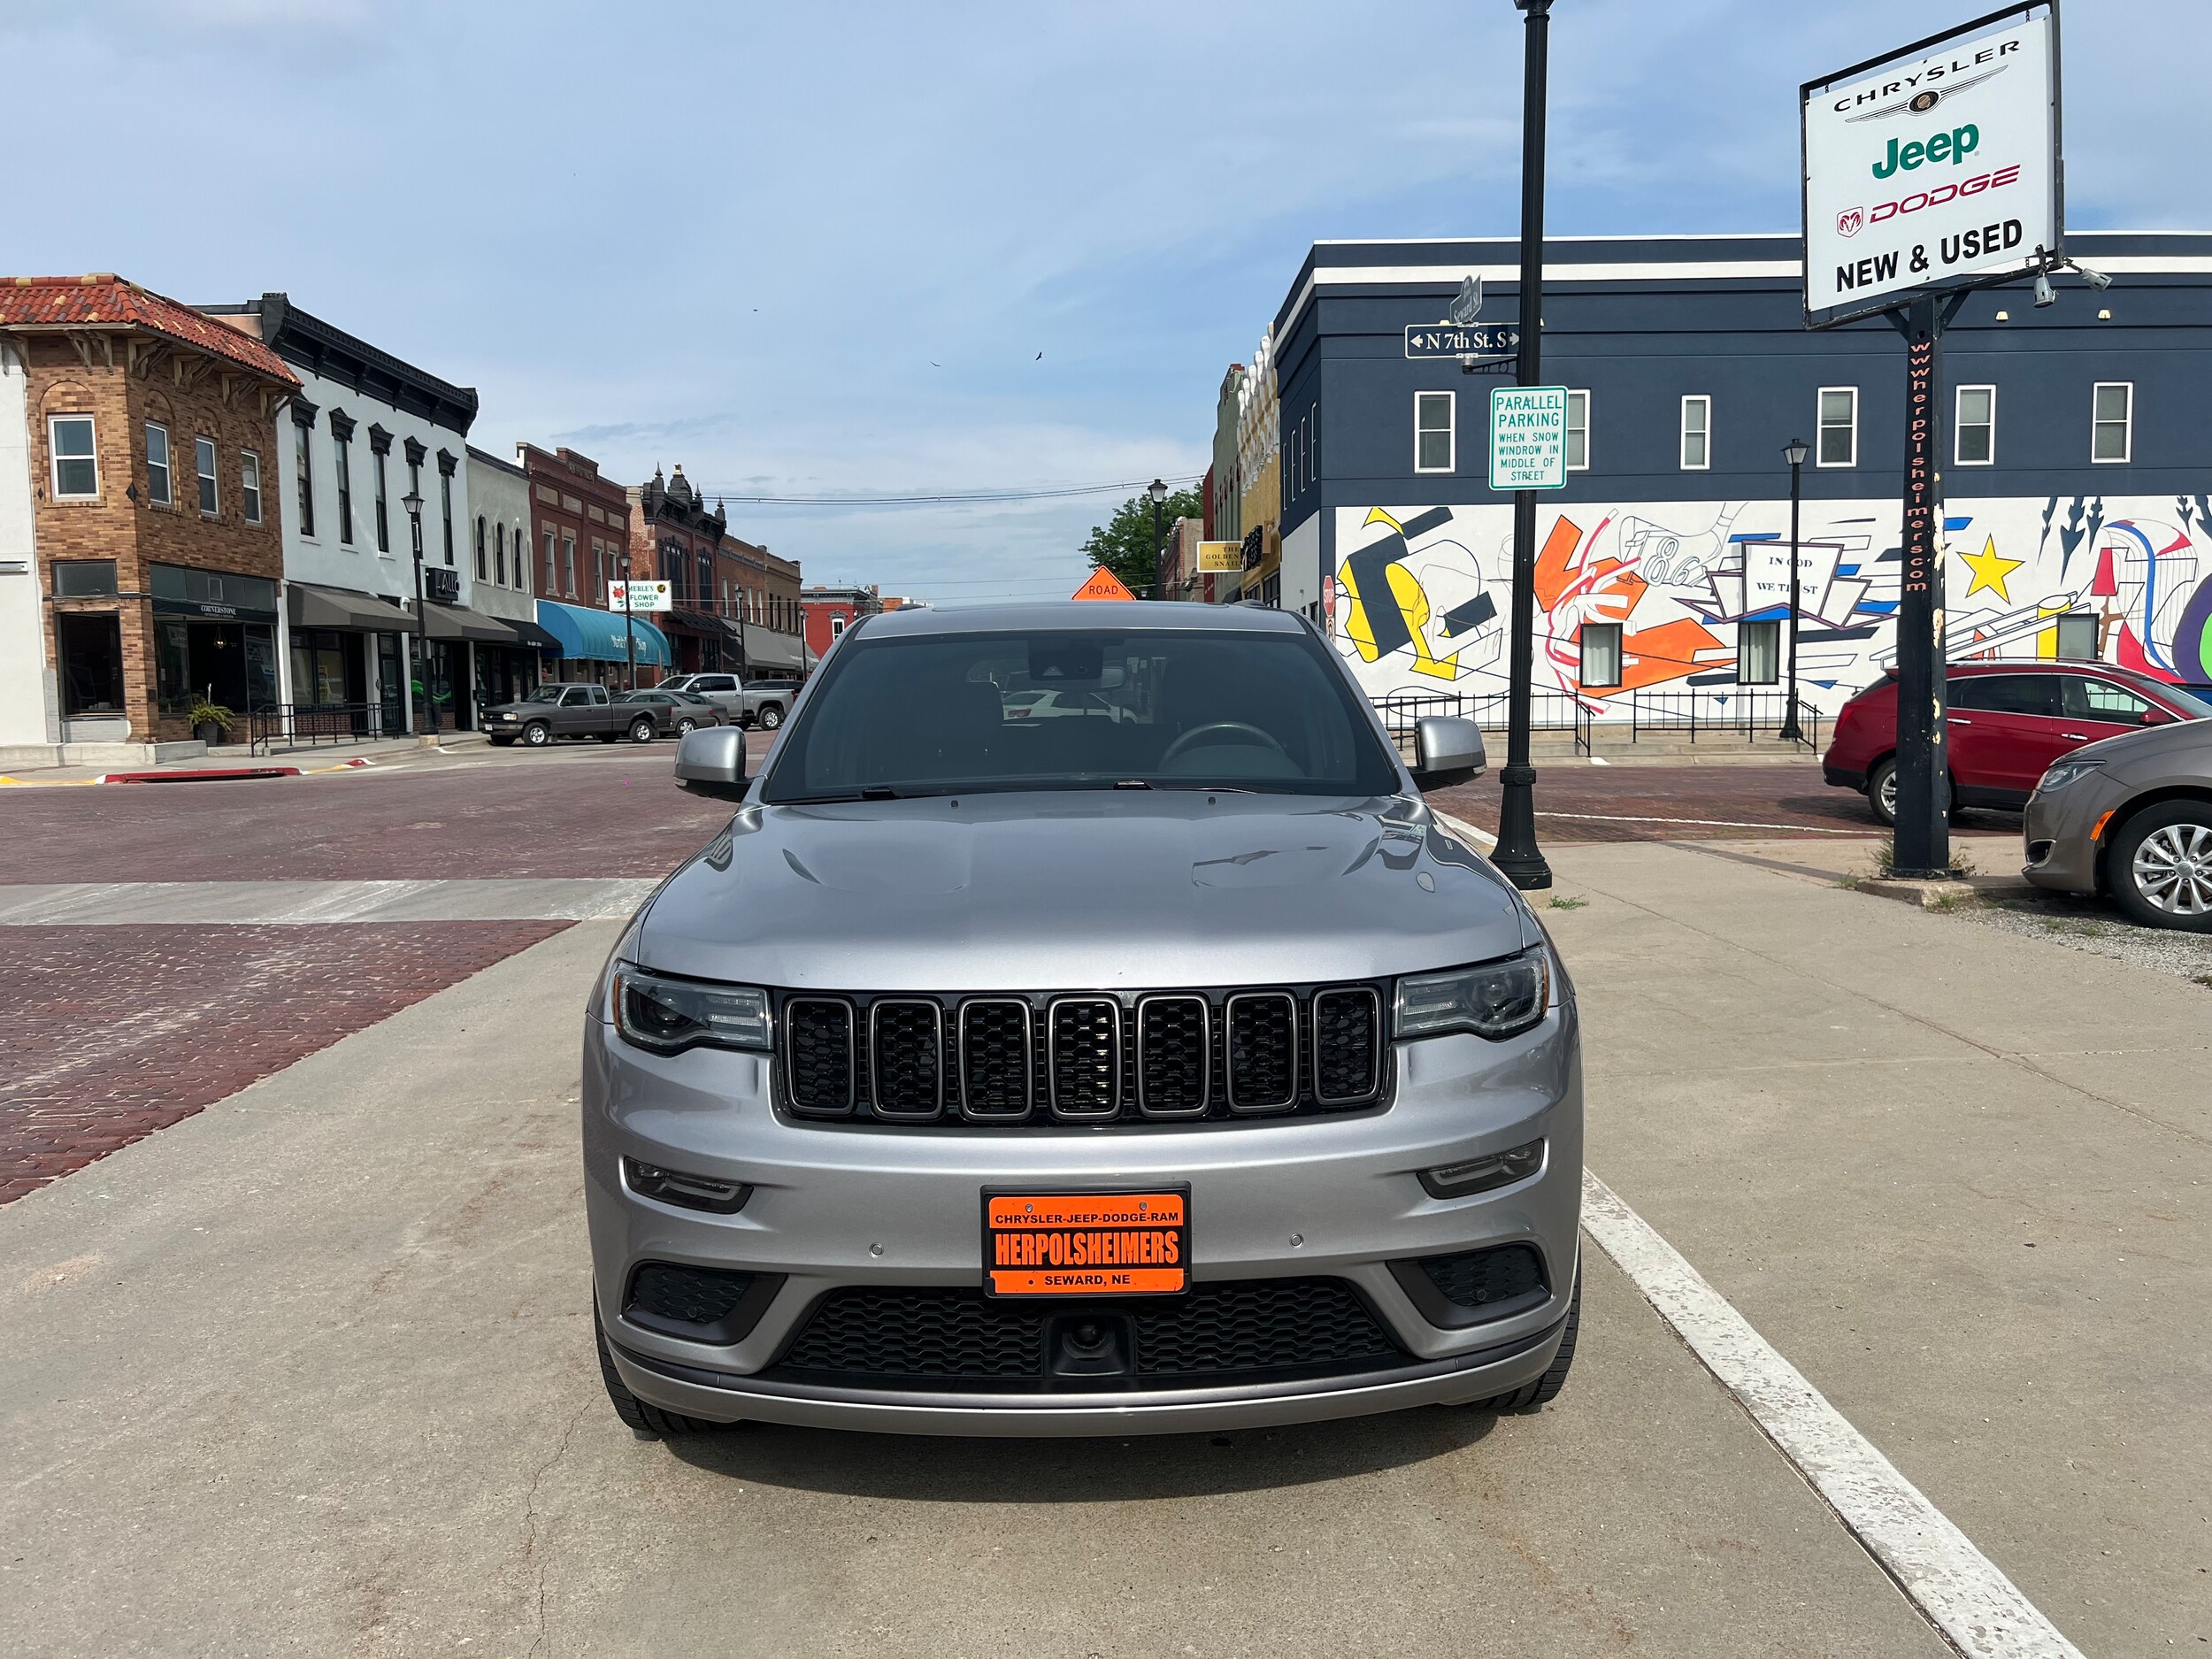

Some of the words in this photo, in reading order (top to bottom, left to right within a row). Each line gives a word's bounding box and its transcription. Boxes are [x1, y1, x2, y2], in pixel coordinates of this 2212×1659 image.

[1833, 41, 2020, 112] CHRYSLER
[1871, 123, 1979, 179] Jeep
[1870, 164, 2021, 223] DODGE
[1836, 251, 1899, 292] NEW
[1909, 244, 1930, 273] &
[1940, 219, 2023, 265] USED
[1425, 334, 1440, 349] N
[1444, 332, 1470, 349] 7th
[1473, 332, 1494, 349] St.
[1496, 332, 1507, 348] S
[1496, 396, 1562, 411] PARALLEL
[1498, 412, 1559, 427] PARKING
[1499, 434, 1525, 442] WHEN
[1532, 432, 1559, 442] SNOW
[1499, 446, 1541, 456] WINDROW
[1549, 444, 1559, 454] IN
[1501, 458, 1535, 468] MIDDLE
[1543, 457, 1555, 467] OF
[1510, 471, 1545, 480] STREET
[1089, 586, 1118, 595] ROAD
[1756, 582, 1775, 591] WE
[1324, 588, 1333, 603] STOP
[201, 605, 236, 615] CORNERSTONE
[995, 1212, 1179, 1224] CHRYSLER-JEEP-DODGE-RAM
[995, 1231, 1179, 1265] HERPOLSHEIMERS
[1044, 1275, 1107, 1286] SEWARD,
[1111, 1274, 1131, 1285] NE
